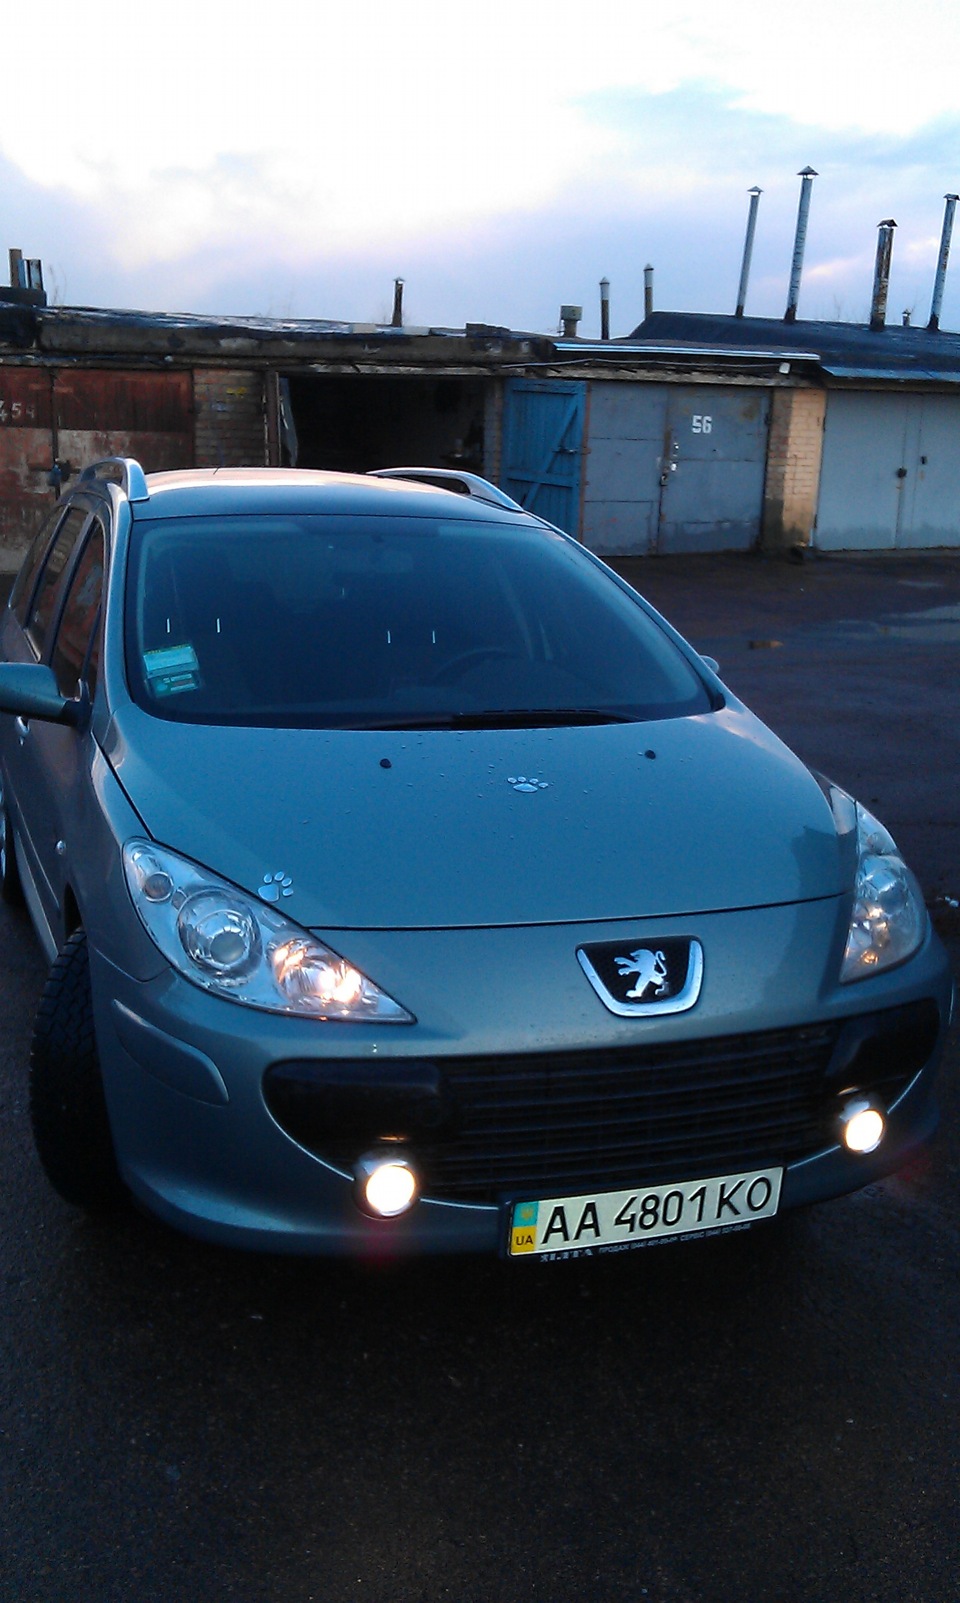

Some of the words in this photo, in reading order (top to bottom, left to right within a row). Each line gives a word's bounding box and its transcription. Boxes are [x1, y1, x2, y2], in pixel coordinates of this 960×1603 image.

[692, 415, 712, 433] 56
[541, 1201, 601, 1245] AA
[613, 1185, 707, 1233] 4801
[715, 1176, 772, 1220] KO
[515, 1234, 534, 1246] UA
